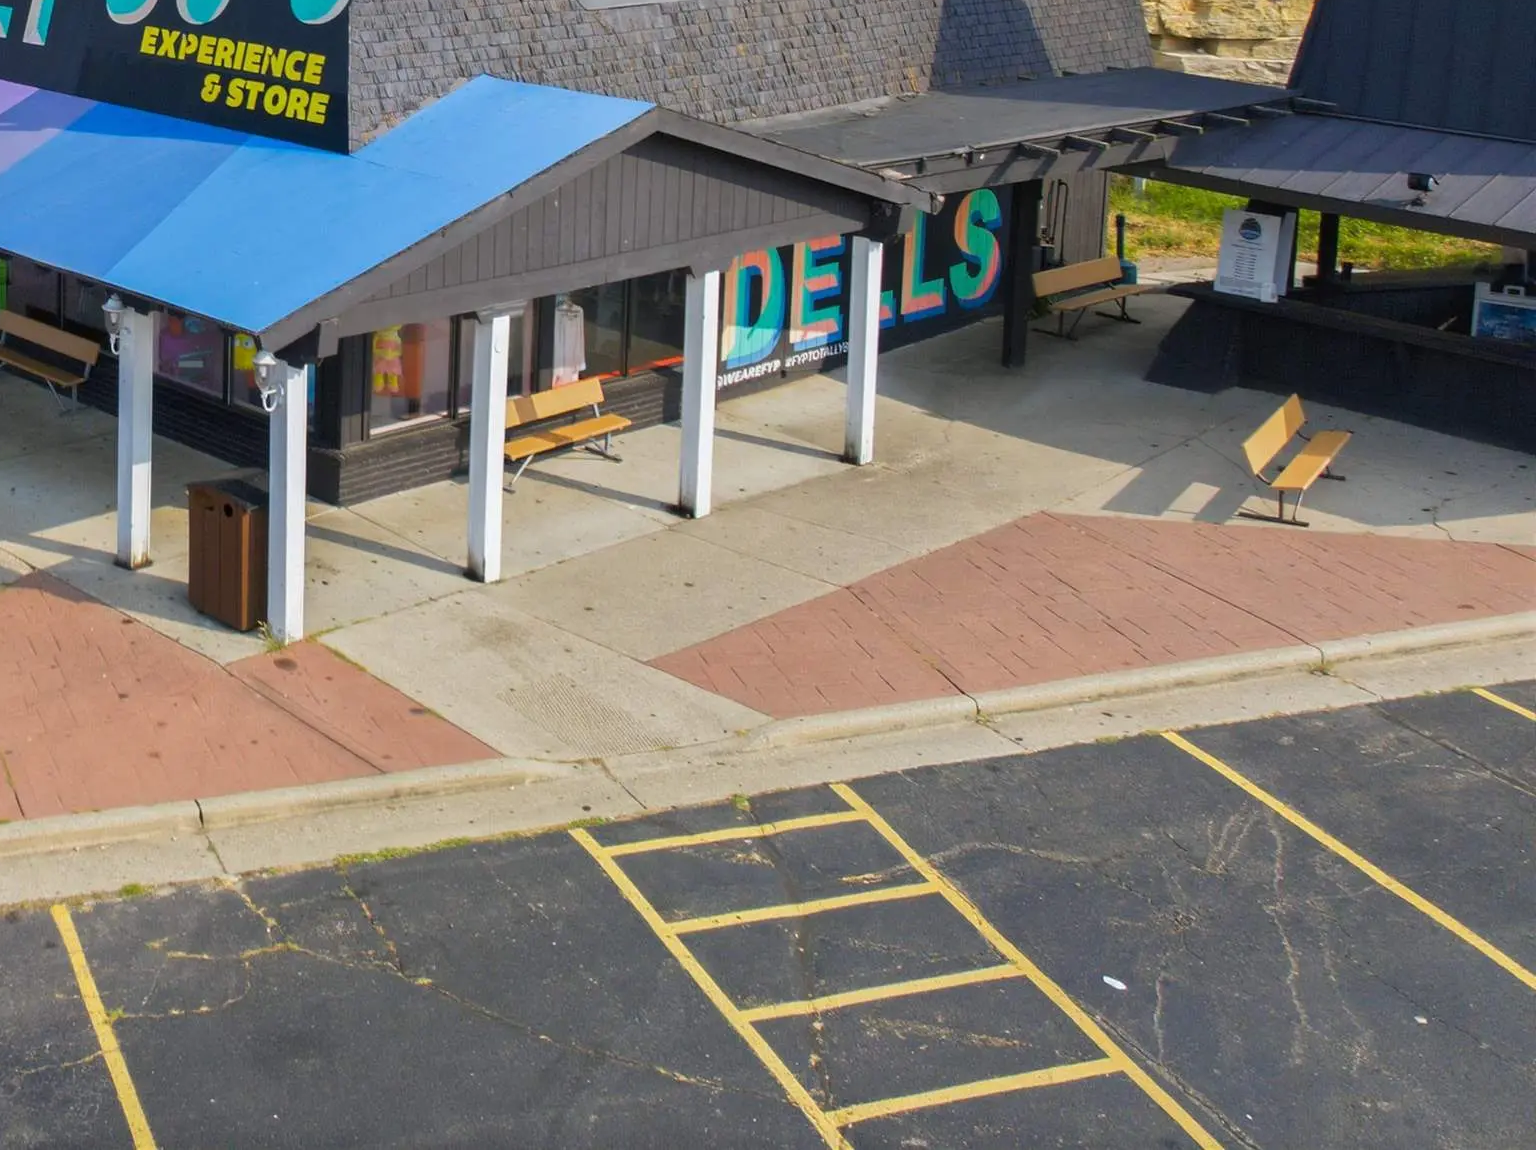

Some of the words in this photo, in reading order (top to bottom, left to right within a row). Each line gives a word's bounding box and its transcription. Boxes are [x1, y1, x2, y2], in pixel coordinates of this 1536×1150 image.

[140, 25, 327, 85] EXPERIENCE
[200, 73, 222, 103] &
[225, 78, 331, 125] STORE
[722, 188, 1003, 369] DELS
